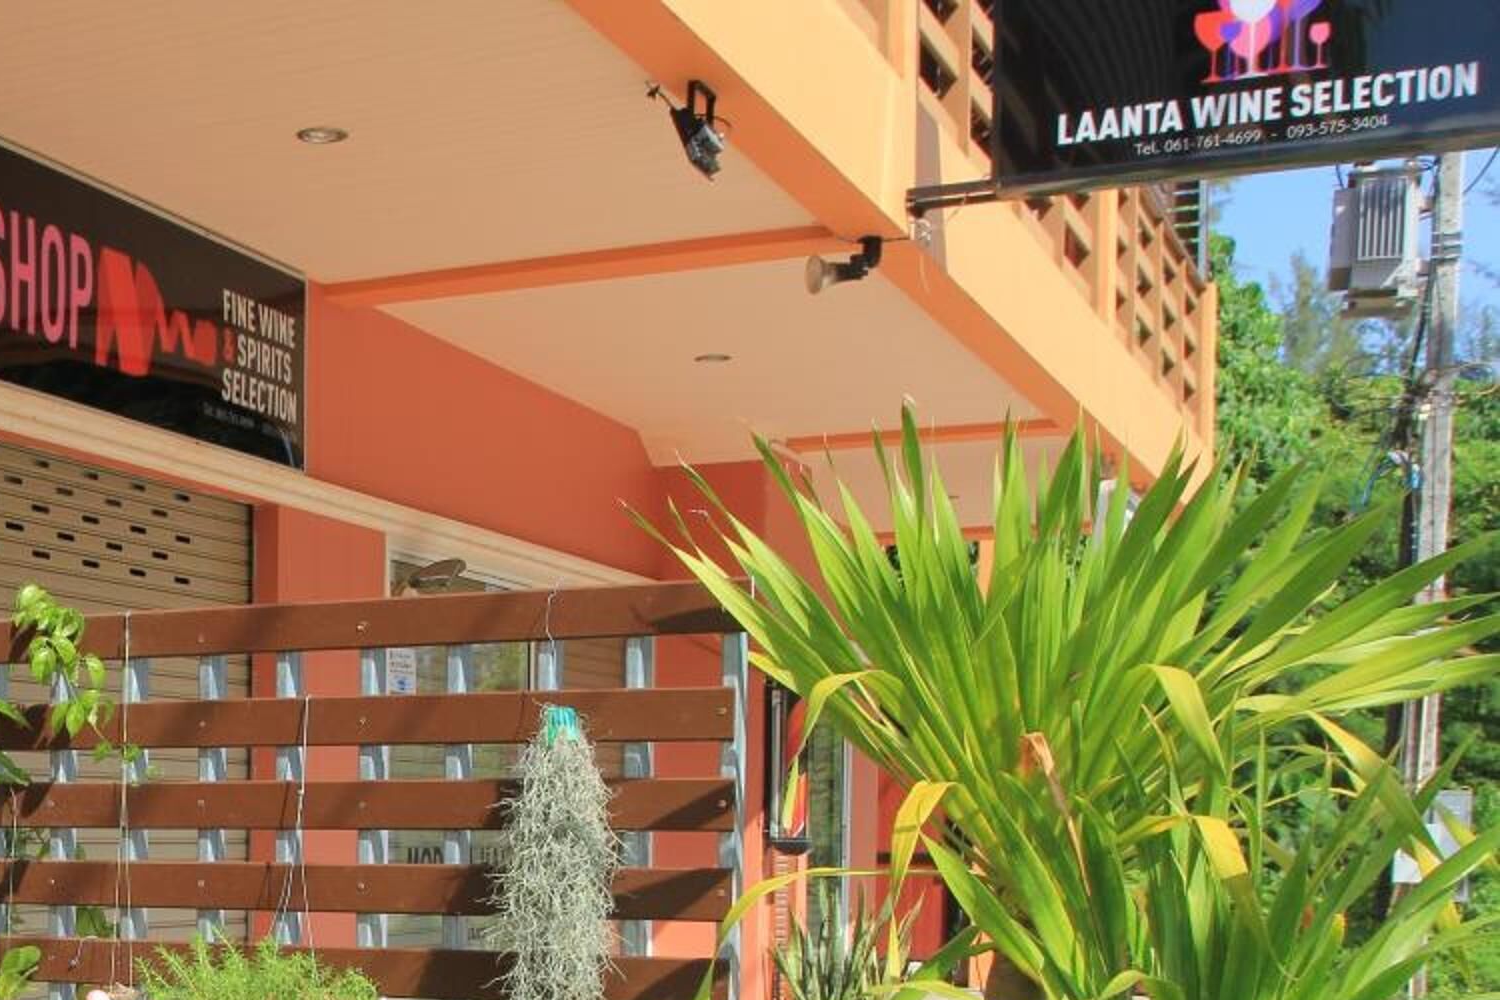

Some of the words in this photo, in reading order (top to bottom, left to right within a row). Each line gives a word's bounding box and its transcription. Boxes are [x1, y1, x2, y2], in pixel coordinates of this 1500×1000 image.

[1057, 99, 1183, 145] LAANTA
[1191, 87, 1284, 129] WINE
[1289, 61, 1479, 118] SELECTION
[1164, 129, 1263, 153] 061-761-4699
[1286, 114, 1389, 139] 093-575-3404
[223, 288, 256, 333] FINE
[258, 303, 296, 349] WINE
[237, 333, 292, 384] SPIRITS
[221, 367, 297, 424] SELECTION
